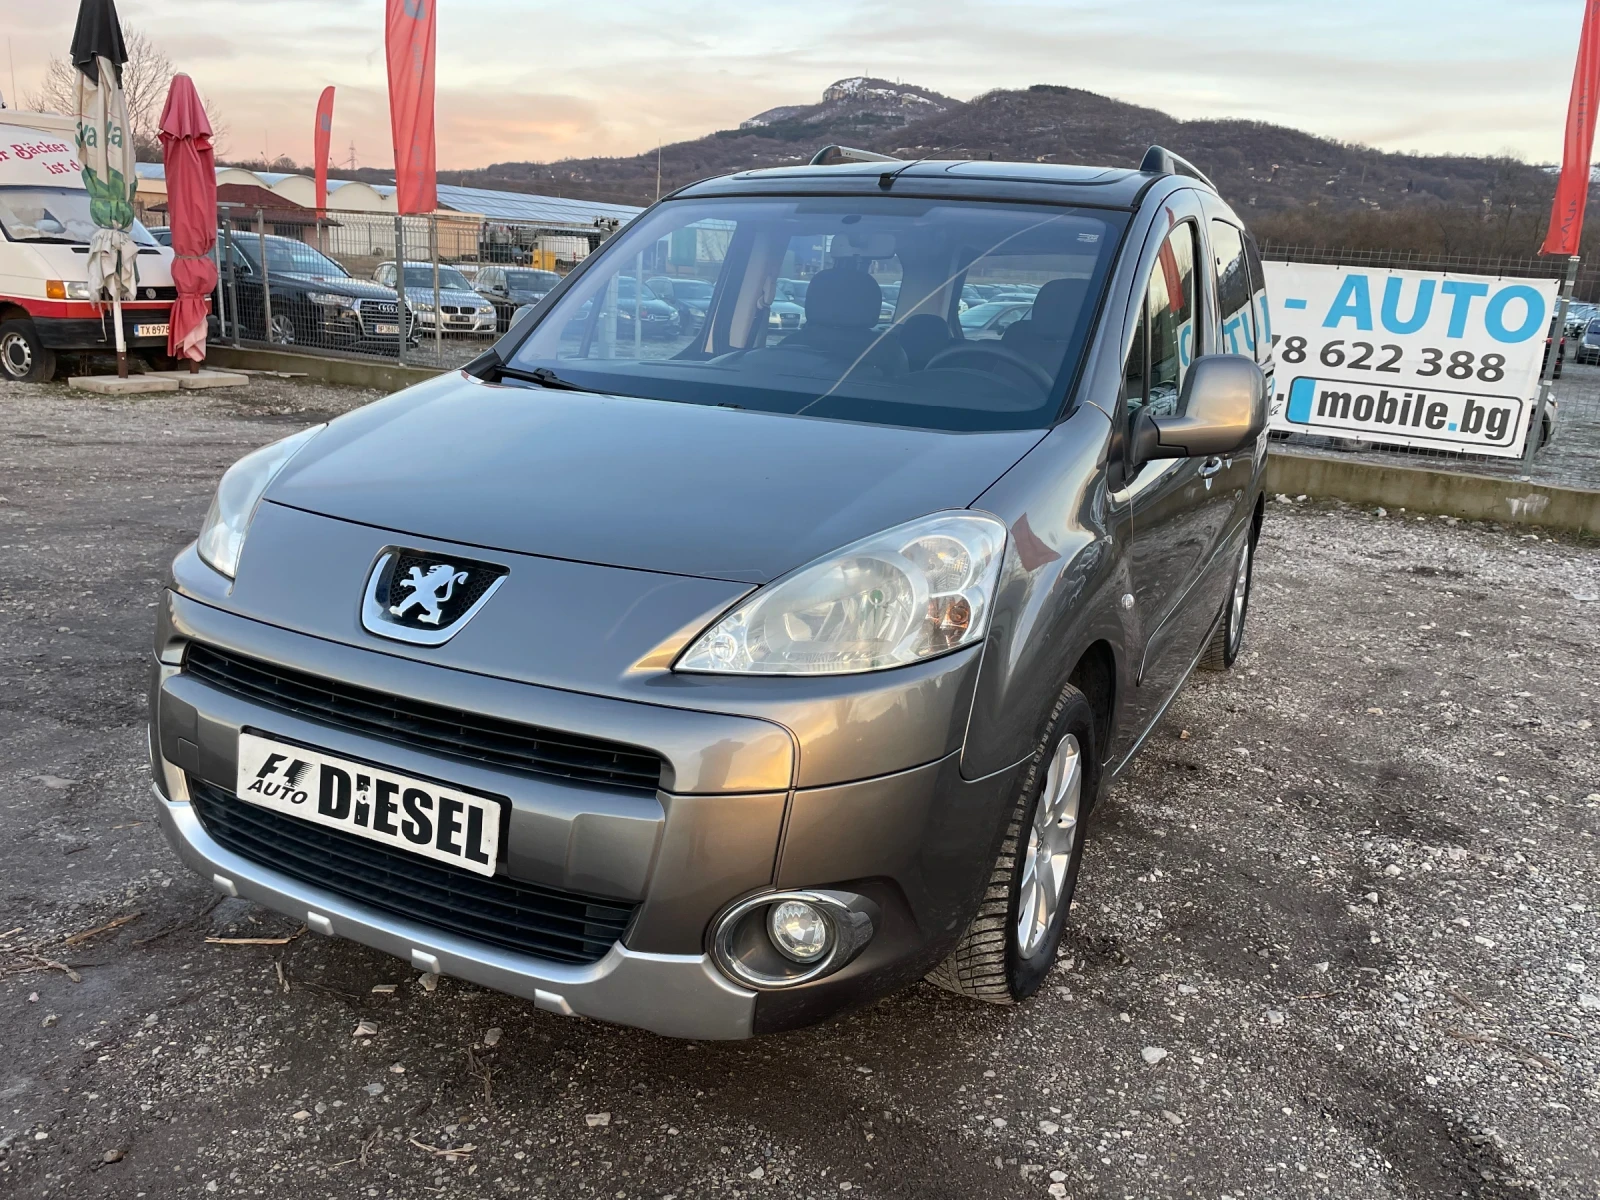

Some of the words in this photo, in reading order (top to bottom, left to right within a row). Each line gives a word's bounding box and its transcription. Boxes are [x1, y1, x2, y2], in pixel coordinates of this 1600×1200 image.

[10, 141, 70, 160] Bäcker
[42, 161, 70, 175] ist
[1322, 274, 1546, 344] AUTO
[1319, 340, 1404, 373] 622
[1416, 347, 1506, 382] 388
[1317, 390, 1511, 441] mobile.bg
[247, 778, 308, 805] AUTO
